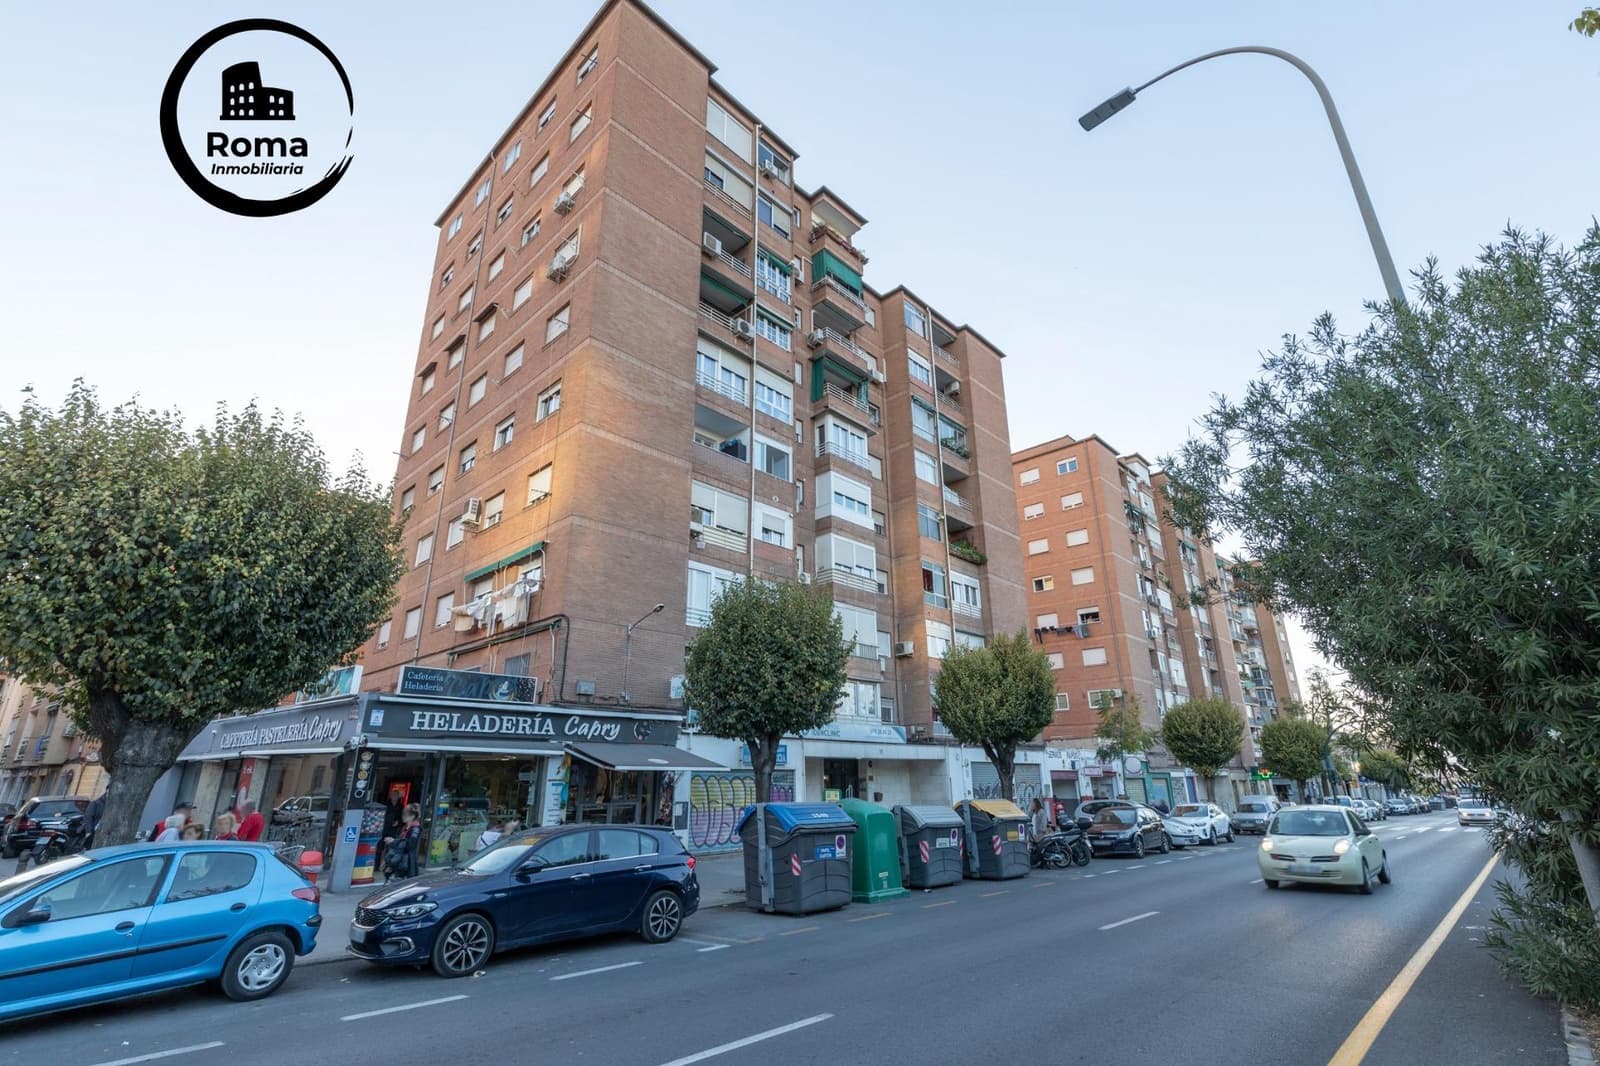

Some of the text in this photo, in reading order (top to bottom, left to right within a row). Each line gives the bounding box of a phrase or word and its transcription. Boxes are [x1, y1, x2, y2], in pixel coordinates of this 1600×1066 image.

[221, 716, 343, 749] CAFETERÍA PASTELERÍA Capry
[409, 711, 621, 741] HELADERÍA Capry
